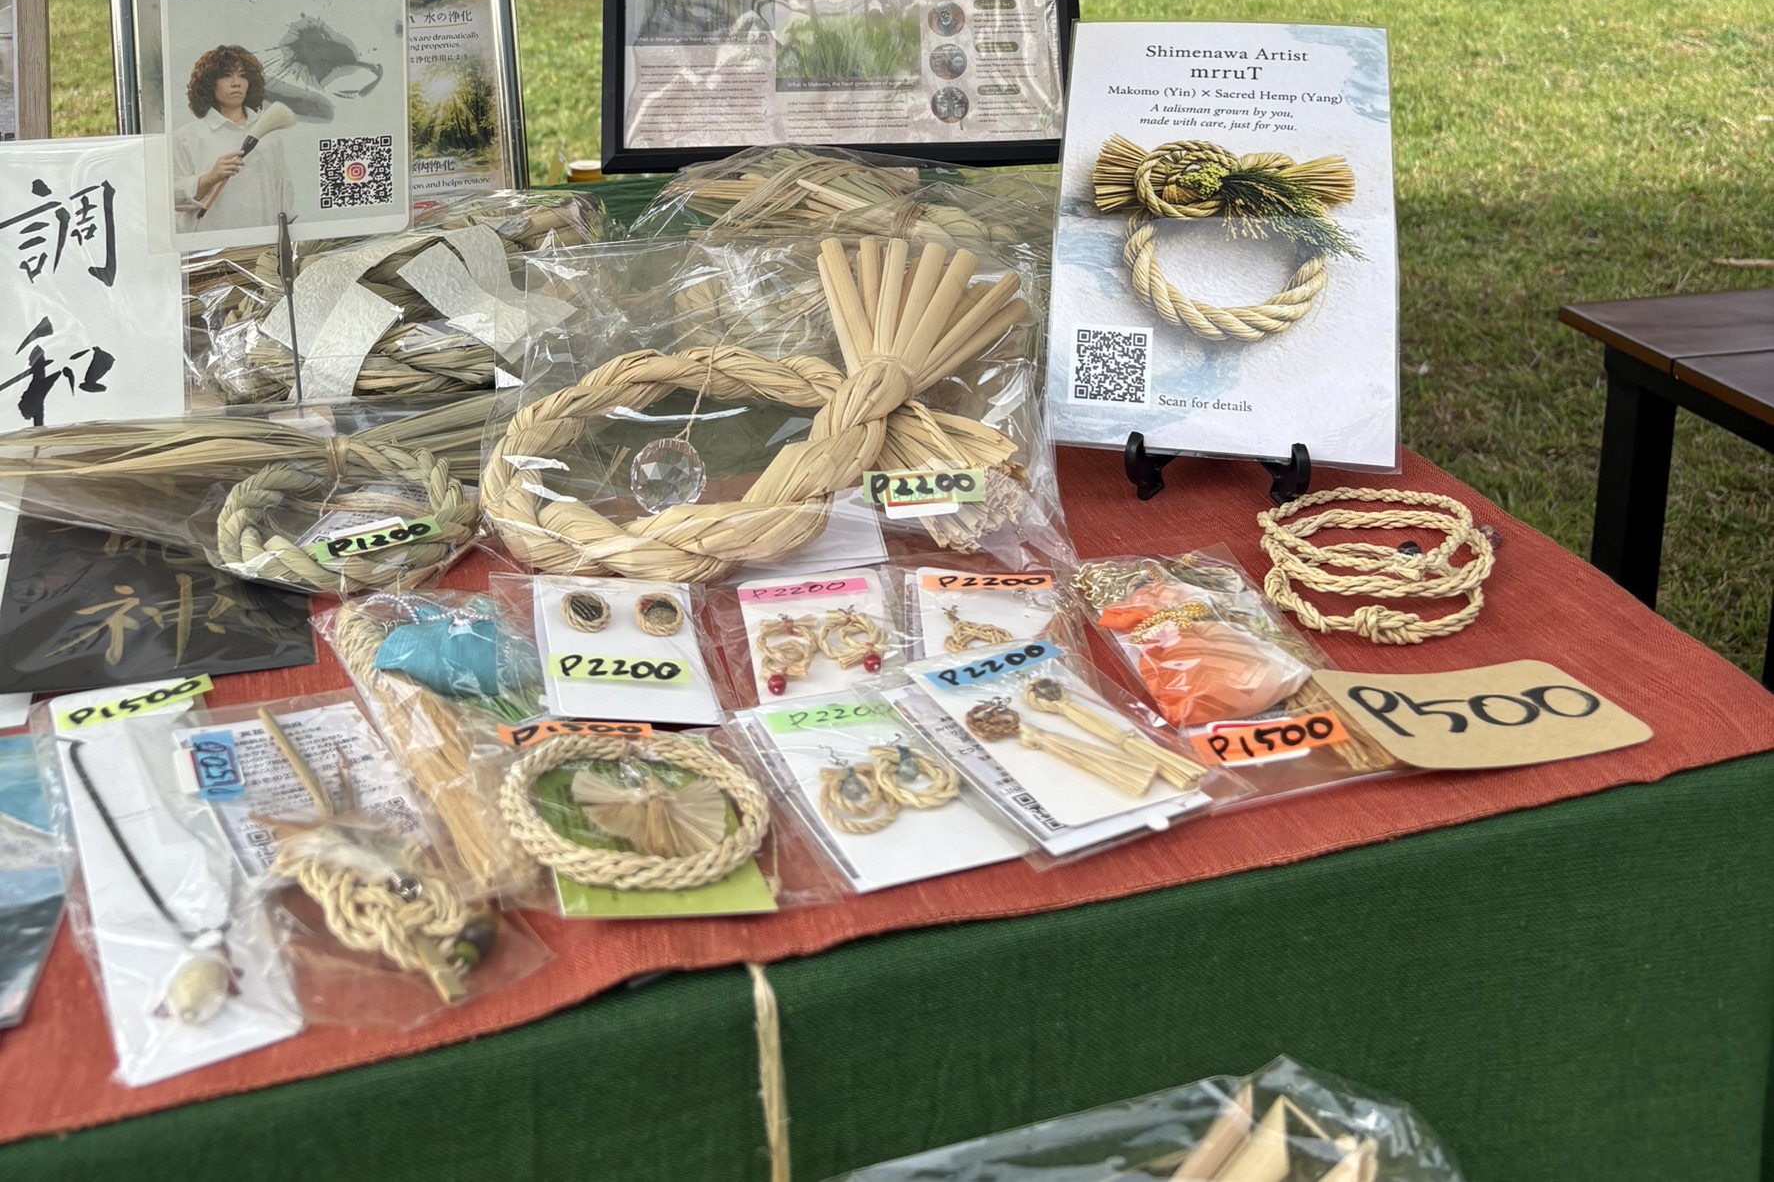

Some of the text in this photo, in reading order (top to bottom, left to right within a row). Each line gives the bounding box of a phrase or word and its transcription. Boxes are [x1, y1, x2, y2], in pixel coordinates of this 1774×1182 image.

[423, 10, 473, 24] 水の浄化
[432, 31, 480, 41] dramatically
[421, 41, 462, 52] properties.
[1146, 45, 1309, 62] Shimenawa Artist
[1190, 66, 1263, 81] mrruT
[1107, 85, 1160, 97] Makomo
[1163, 87, 1197, 99] (Yin)
[1215, 89, 1256, 101] Sacred
[1260, 90, 1297, 104] Hemp
[1301, 92, 1343, 105] (Yang)
[1150, 103, 1294, 120] A talisman grown by you,
[1139, 116, 1298, 133] made with care, just for you.
[425, 179, 441, 188] and
[442, 178, 463, 188] helps
[1158, 394, 1253, 413] Scan for details
[870, 473, 976, 504] P2200
[327, 523, 432, 557] P1200
[752, 581, 846, 600] P2200
[938, 575, 1047, 589] P2200
[559, 654, 681, 680] P2200
[938, 644, 1046, 686] P2200
[68, 679, 202, 725] P1500
[512, 722, 644, 746] P1500
[1207, 716, 1334, 762] P1500
